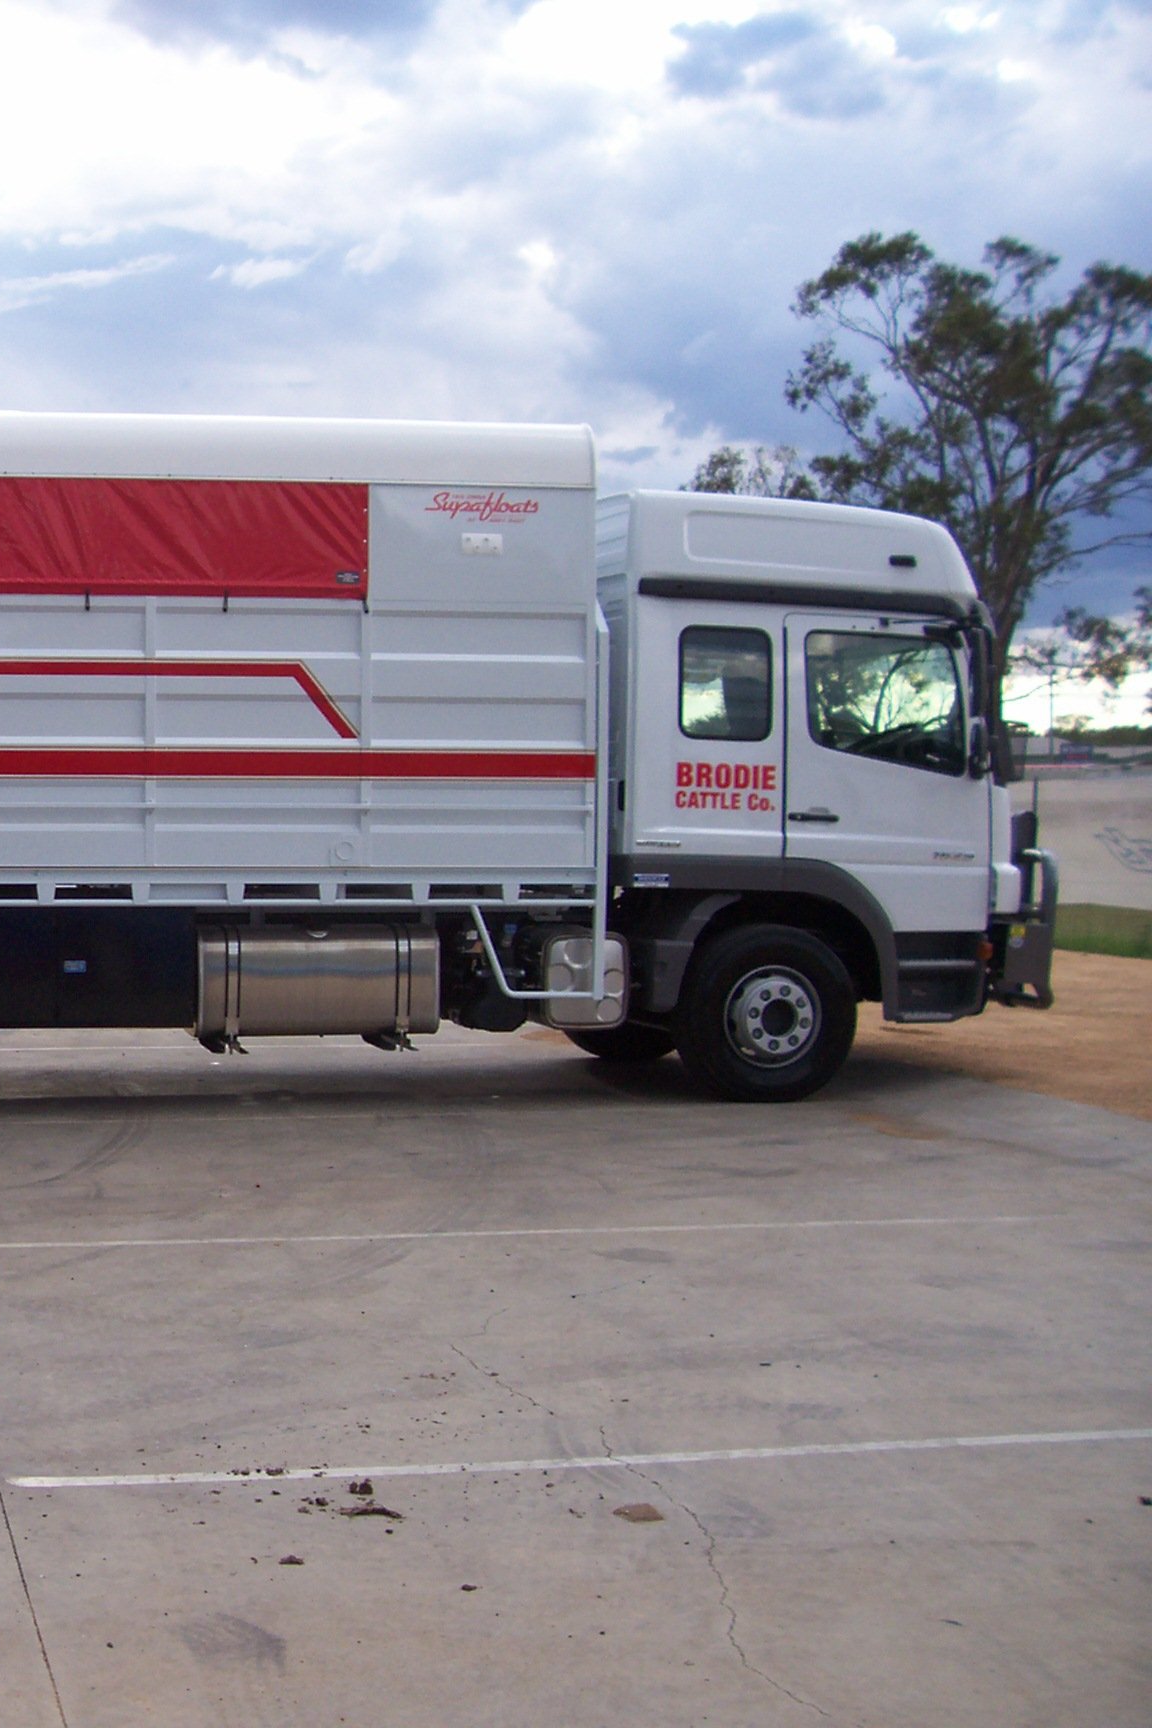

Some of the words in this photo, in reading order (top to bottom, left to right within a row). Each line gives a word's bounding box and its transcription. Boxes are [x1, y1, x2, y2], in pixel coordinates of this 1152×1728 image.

[425, 492, 538, 521] Supafloats
[676, 762, 776, 790] BRODIE
[675, 790, 741, 810] CATTLE
[747, 793, 775, 811] Co.
